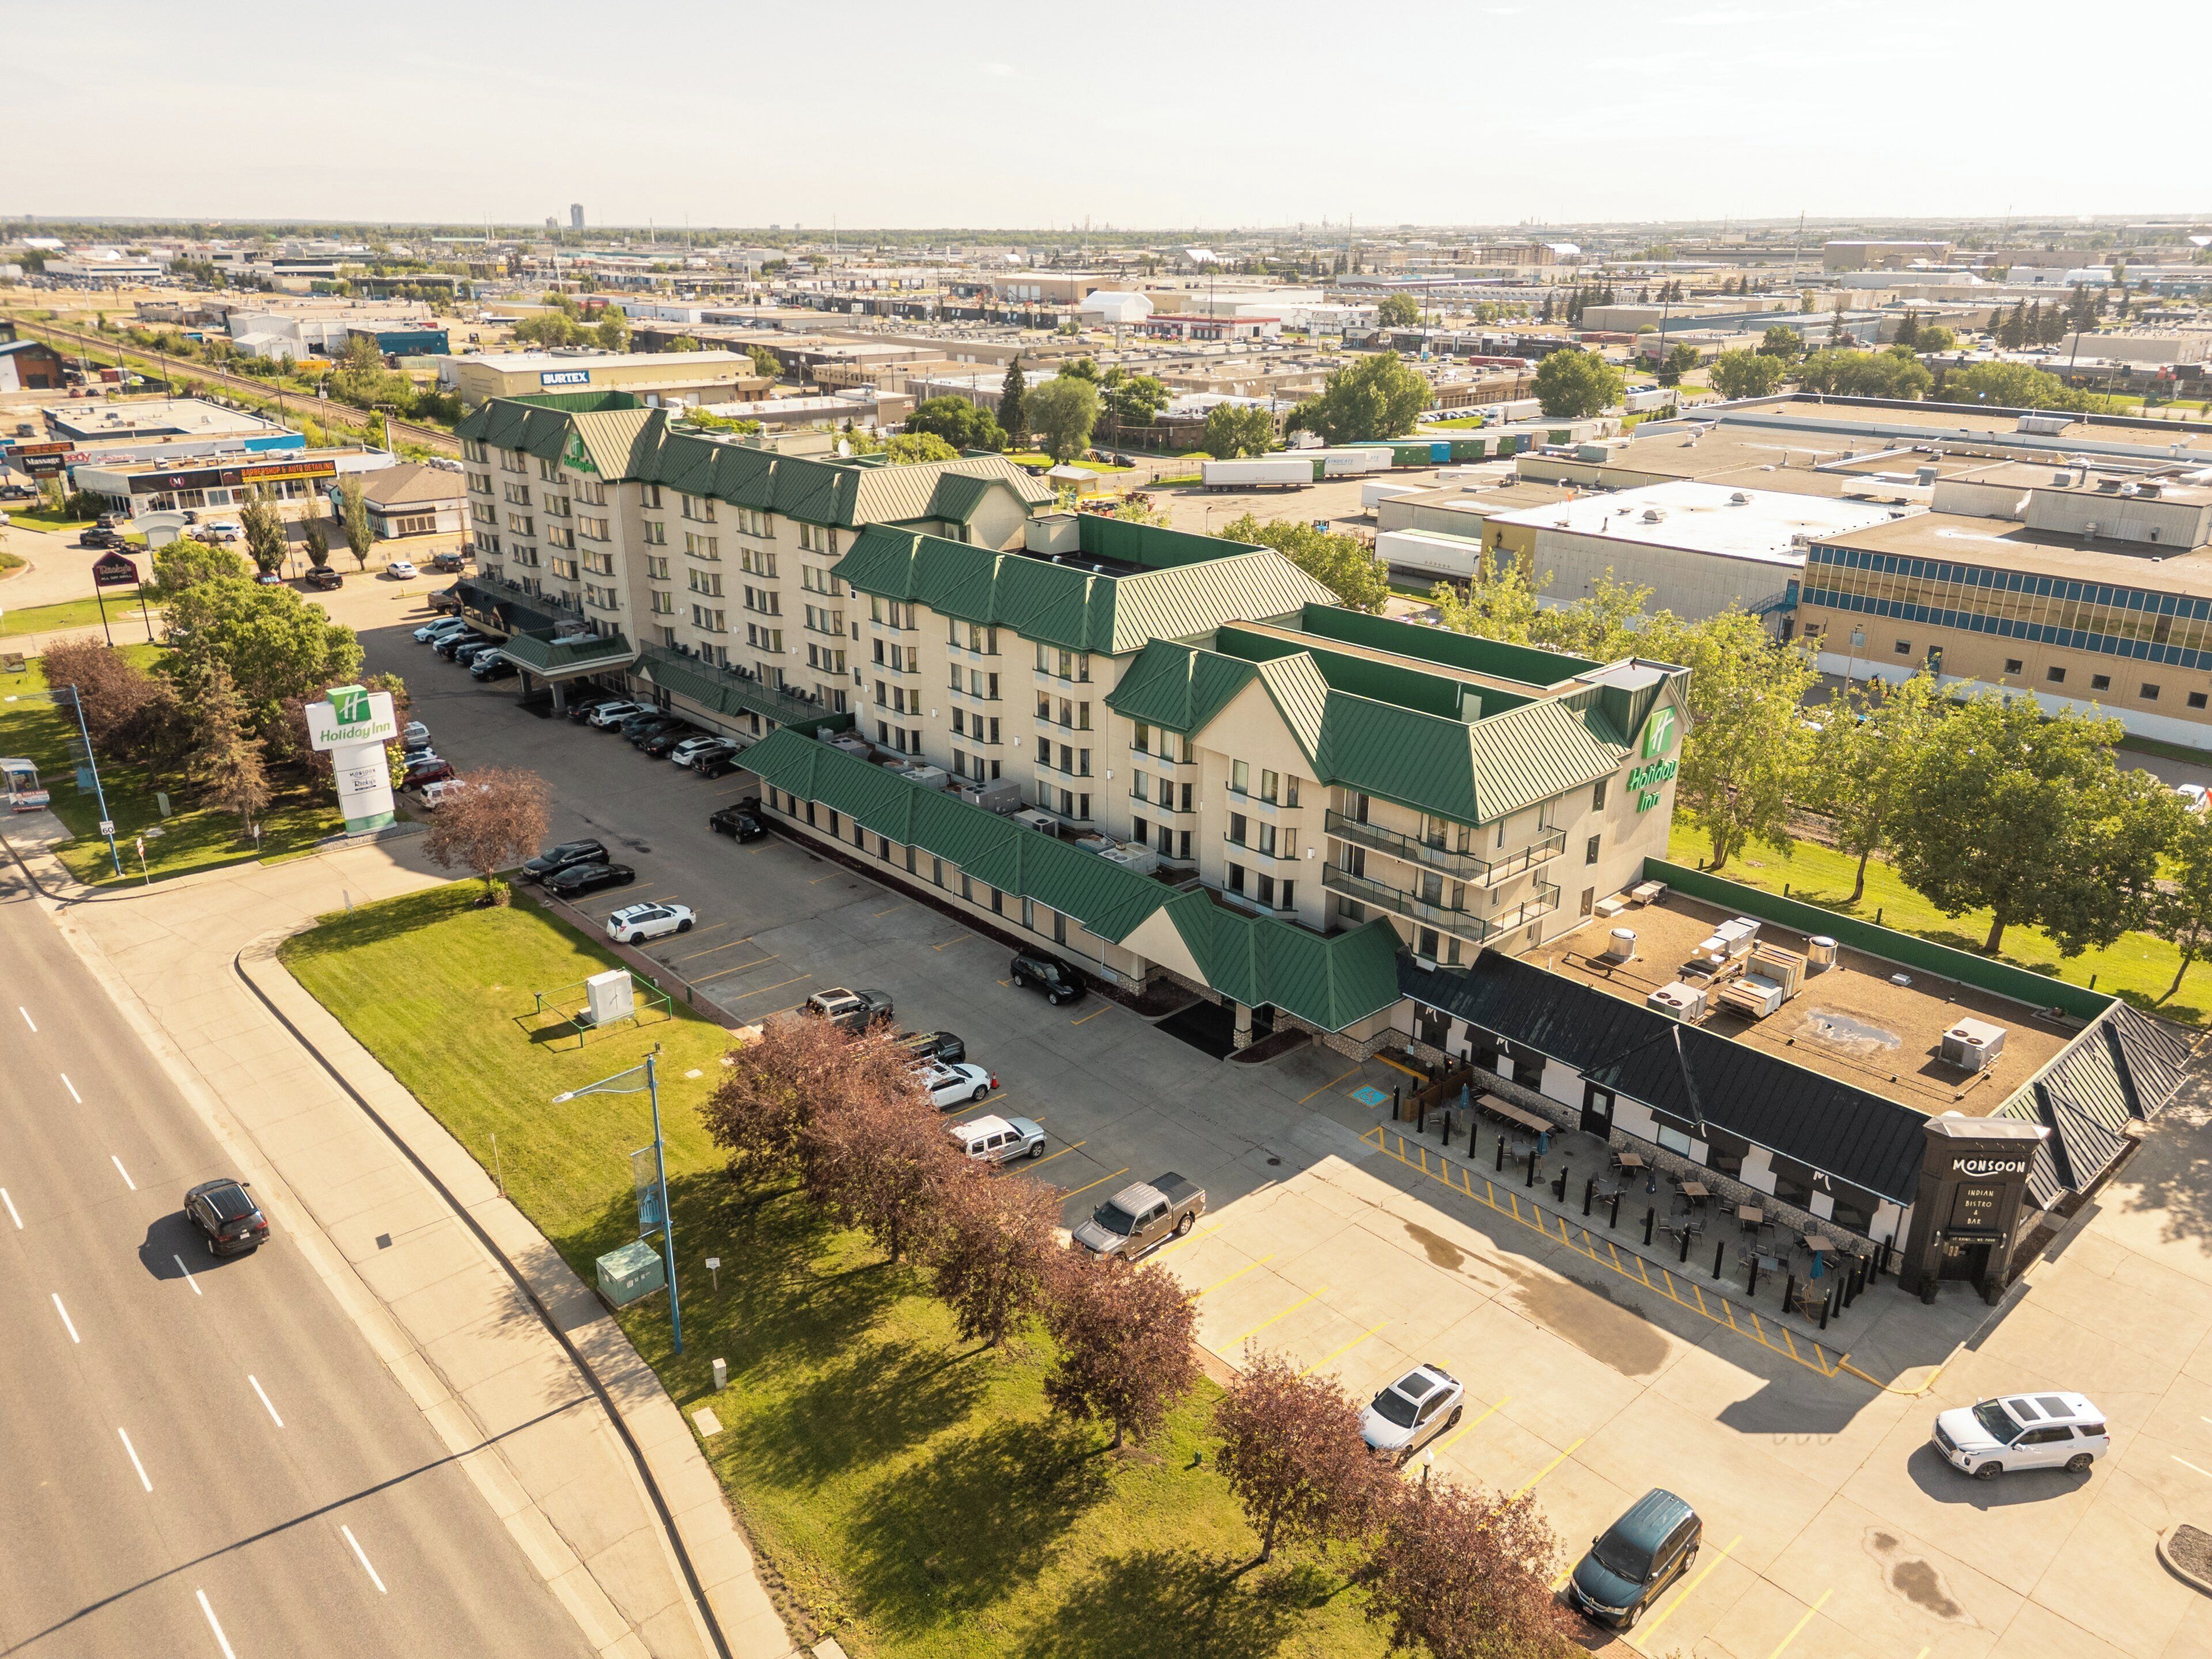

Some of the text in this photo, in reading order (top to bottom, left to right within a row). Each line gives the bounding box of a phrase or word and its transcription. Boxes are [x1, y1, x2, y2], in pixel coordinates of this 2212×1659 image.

[543, 372, 588, 384] BURTEX
[26, 457, 60, 466] Massage
[64, 452, 92, 462] eedy
[564, 454, 586, 473] Holiday
[241, 465, 280, 477] BARBERSHOP
[289, 464, 303, 473] AUTO
[304, 462, 334, 472] DETAILING
[320, 722, 391, 743] Holiday Inn
[350, 768, 376, 778] MONSOON
[1627, 758, 1679, 793] Holiday
[1637, 790, 1660, 813] Inn
[1953, 1158, 2025, 1177] MONSOON
